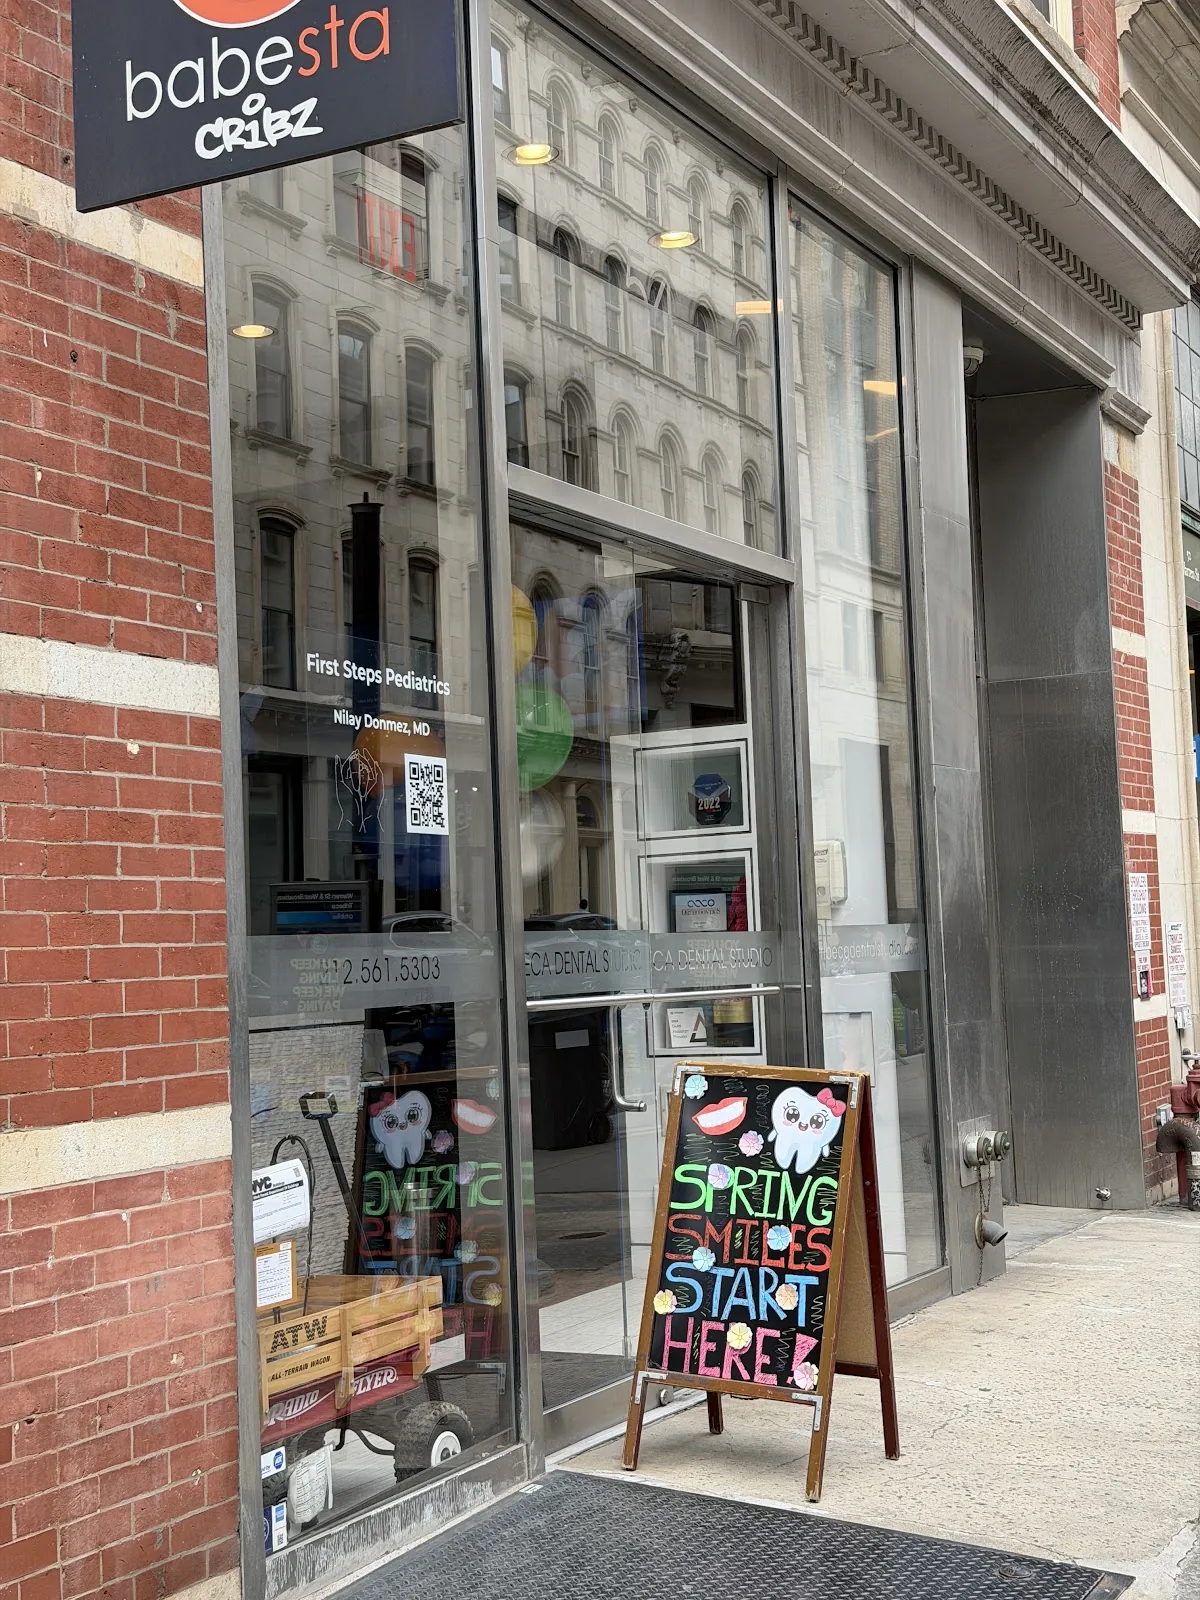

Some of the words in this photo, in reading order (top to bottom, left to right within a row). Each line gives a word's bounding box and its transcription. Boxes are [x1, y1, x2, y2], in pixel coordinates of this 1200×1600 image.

[125, 4, 391, 122] babesta
[306, 653, 340, 677] First
[342, 660, 383, 686] Steps
[385, 668, 451, 696] Pediatrics
[333, 709, 362, 730] Nilay
[364, 714, 411, 736] Donmez,
[412, 722, 431, 736] MD
[698, 797, 720, 811] 2022
[554, 949, 601, 975] DENTAL
[678, 948, 728, 971] DENTAL
[729, 947, 773, 968] STUDIO
[252, 1176, 272, 1193] NYC
[669, 1163, 839, 1226] SPRING
[665, 1213, 833, 1273] SMILES
[665, 1261, 819, 1328] START
[269, 1315, 328, 1354] ATW
[271, 1363, 309, 1382] ALL-TERRAIN
[310, 1355, 331, 1368] WAGON
[267, 1389, 320, 1426] RADIO
[350, 1365, 397, 1397] FLYER
